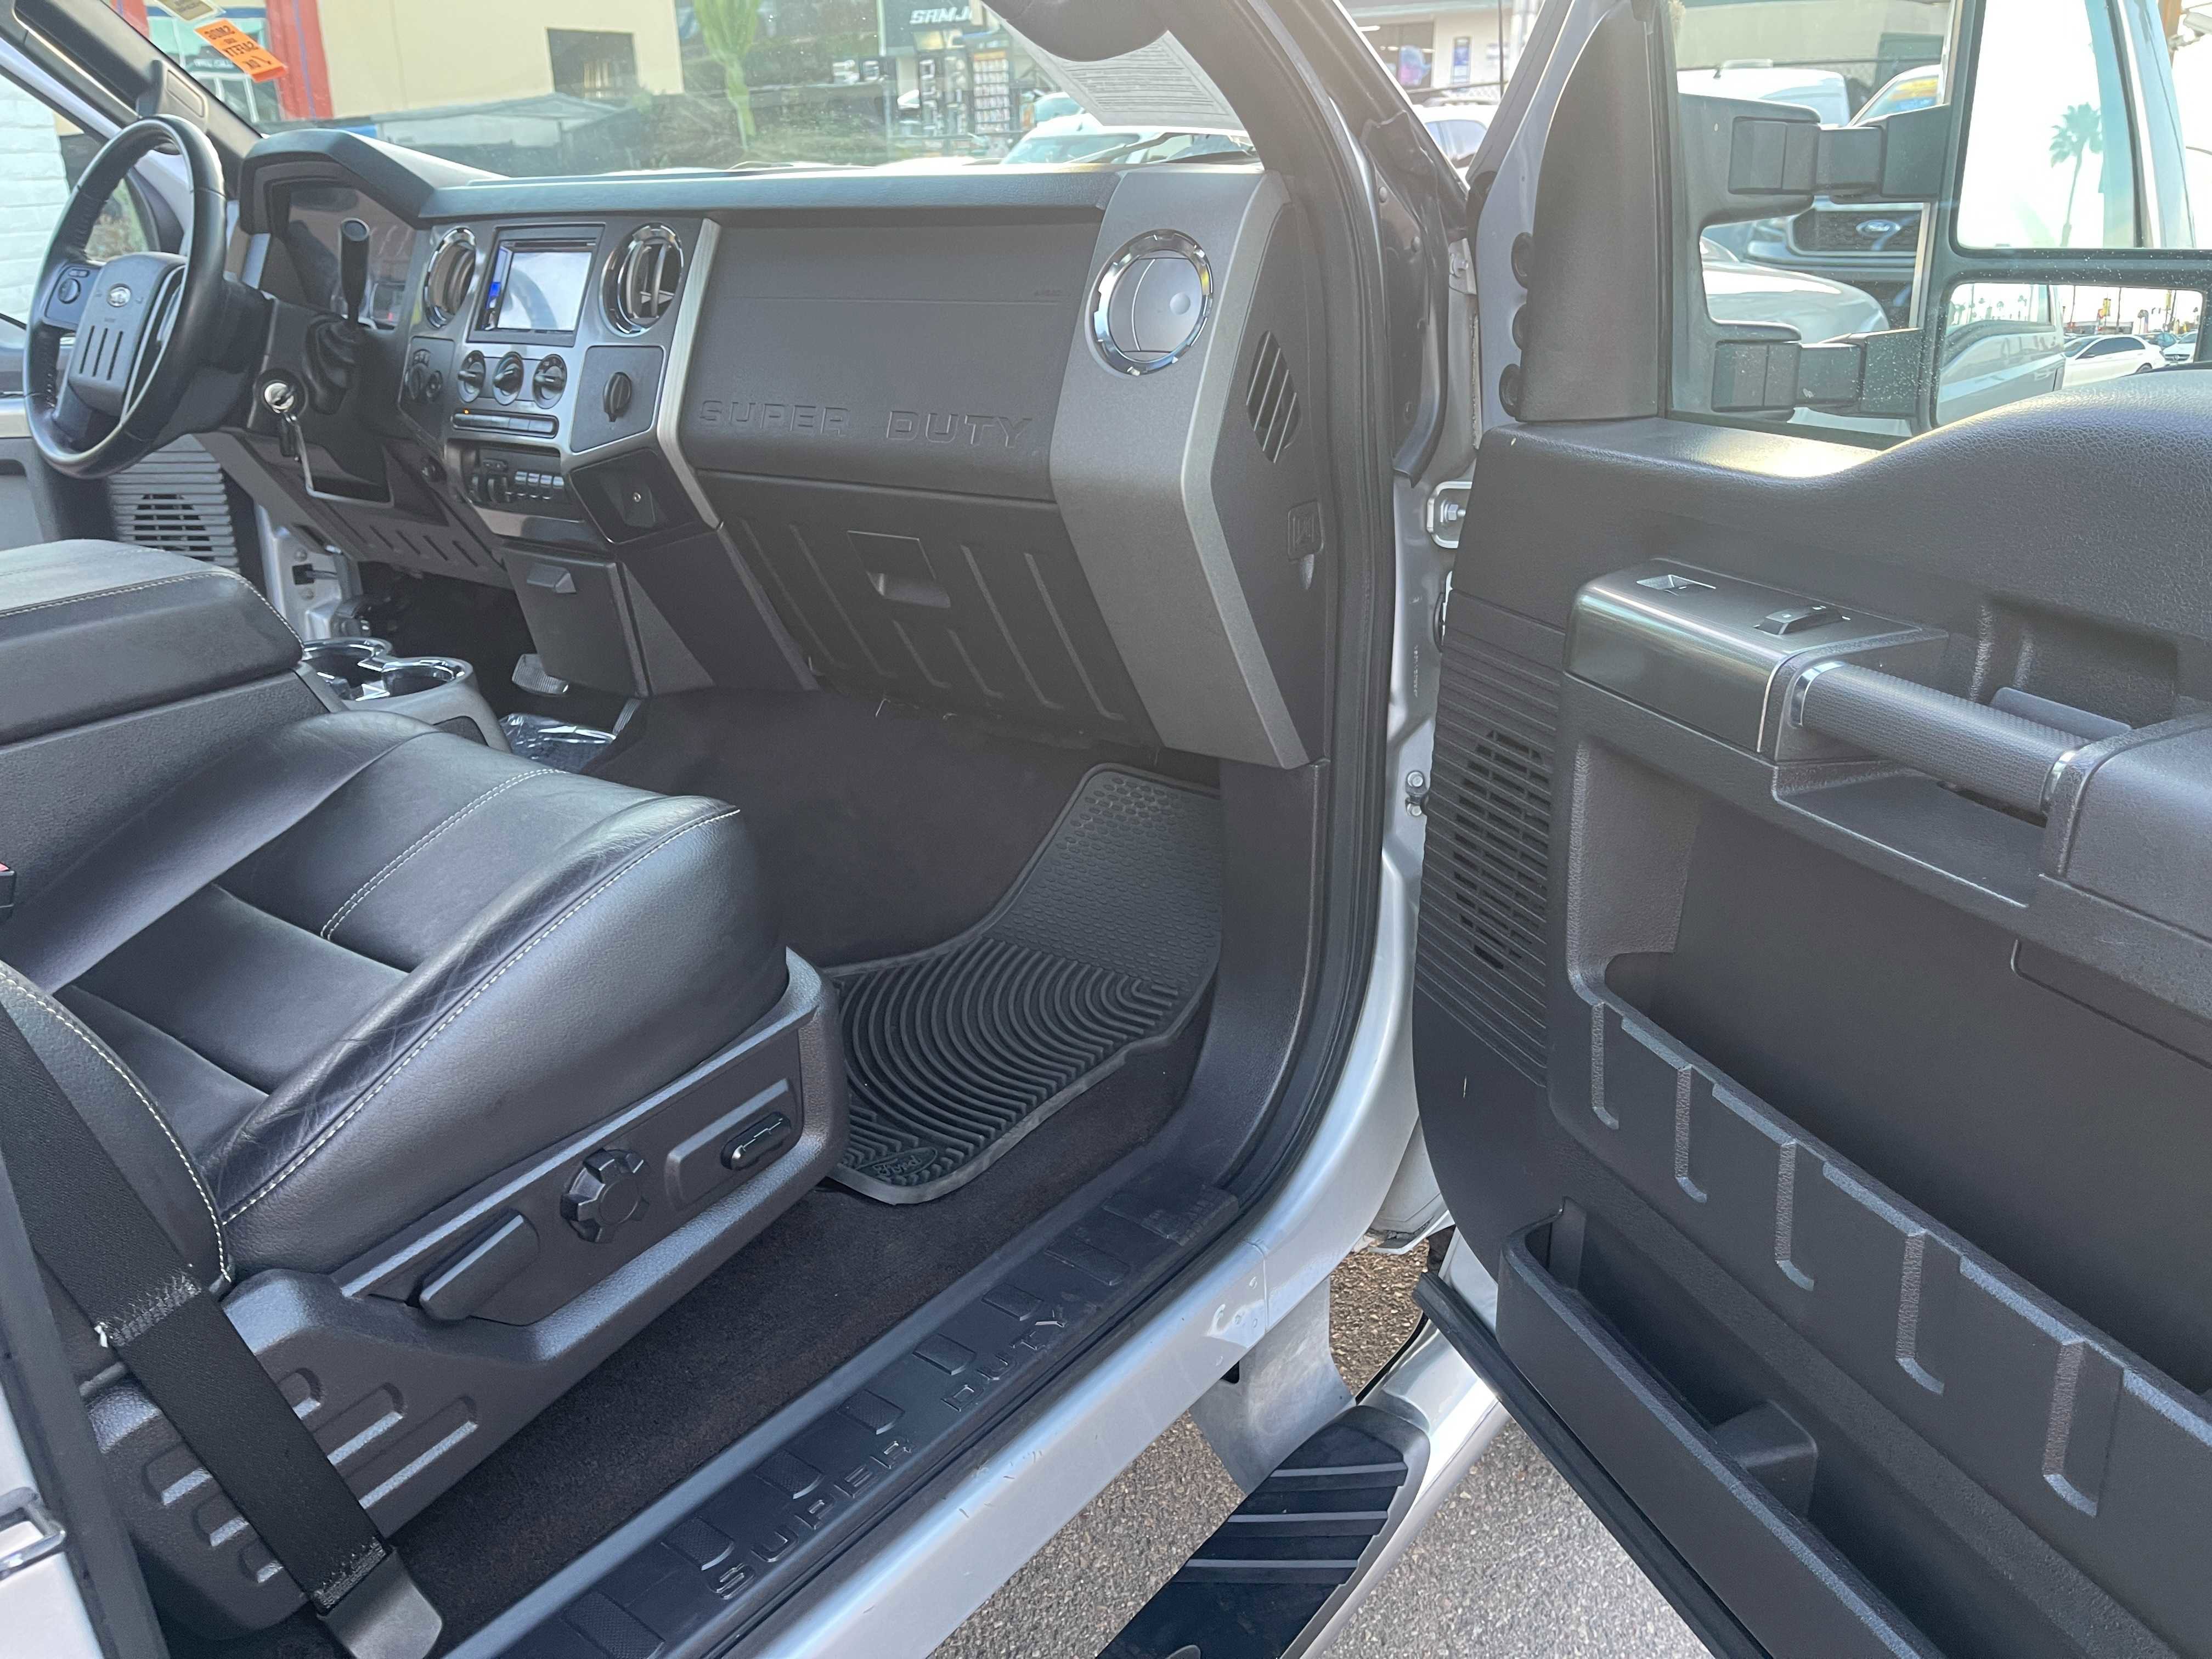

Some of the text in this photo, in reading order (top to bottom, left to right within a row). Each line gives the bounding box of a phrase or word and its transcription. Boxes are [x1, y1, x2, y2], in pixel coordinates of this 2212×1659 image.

[909, 6, 974, 25] SAMJ
[699, 400, 1032, 448] SUPER DUTY
[706, 1305, 1069, 1601] SUPER DUTY
